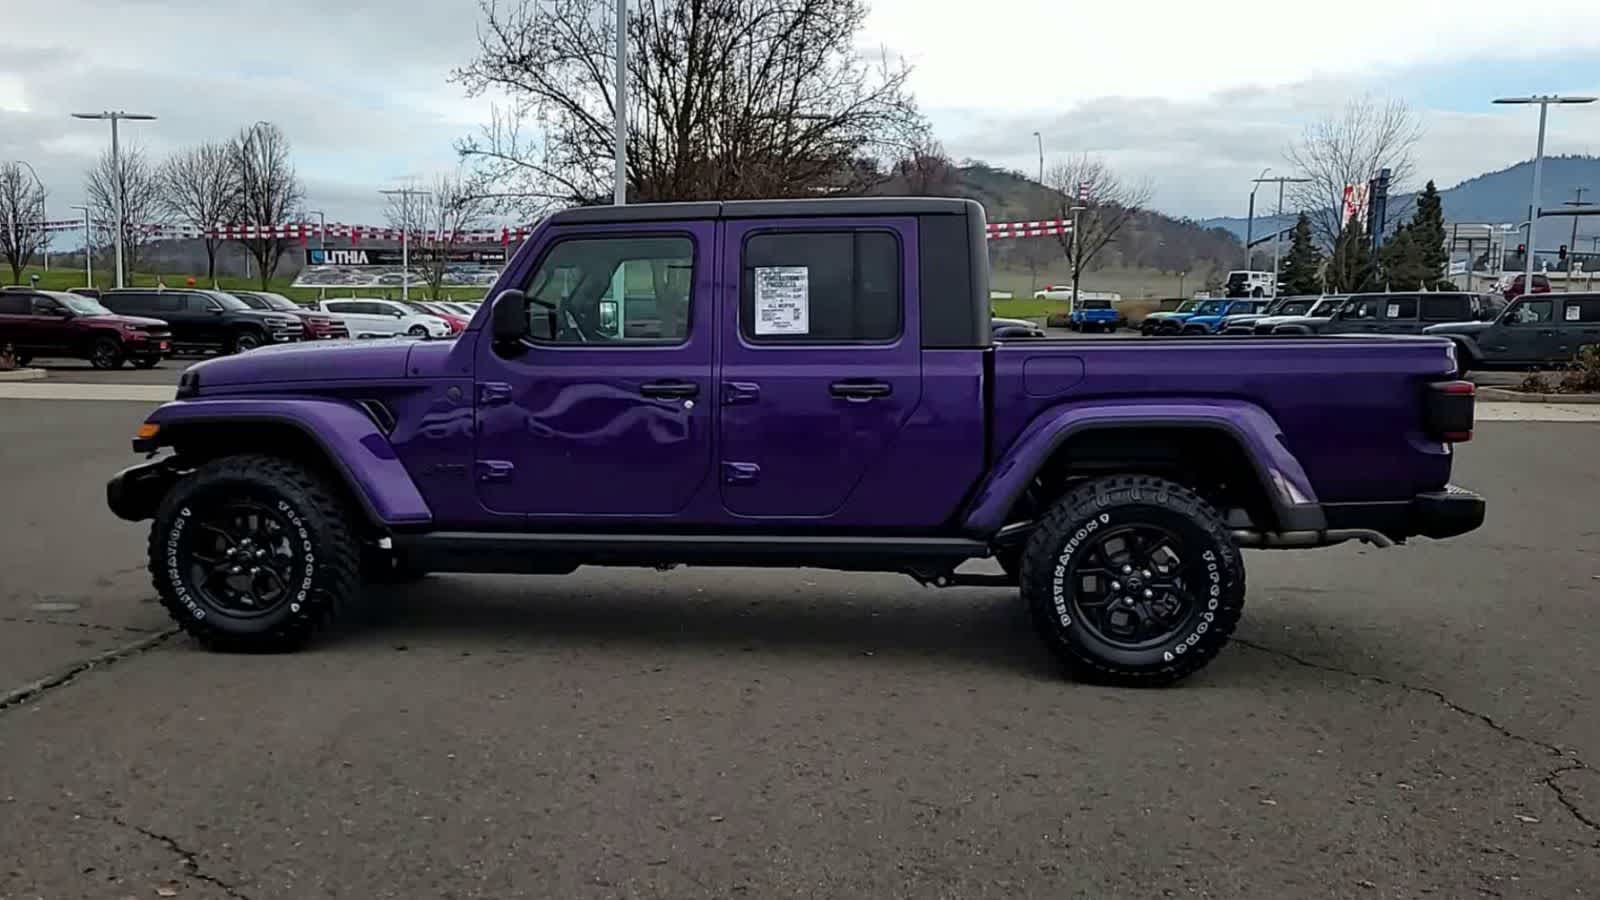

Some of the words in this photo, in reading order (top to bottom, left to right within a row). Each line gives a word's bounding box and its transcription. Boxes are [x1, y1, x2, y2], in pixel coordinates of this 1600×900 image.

[324, 250, 369, 264] LITHIA
[167, 518, 206, 620] DESTINATION
[1053, 519, 1098, 627] DESTINATION
